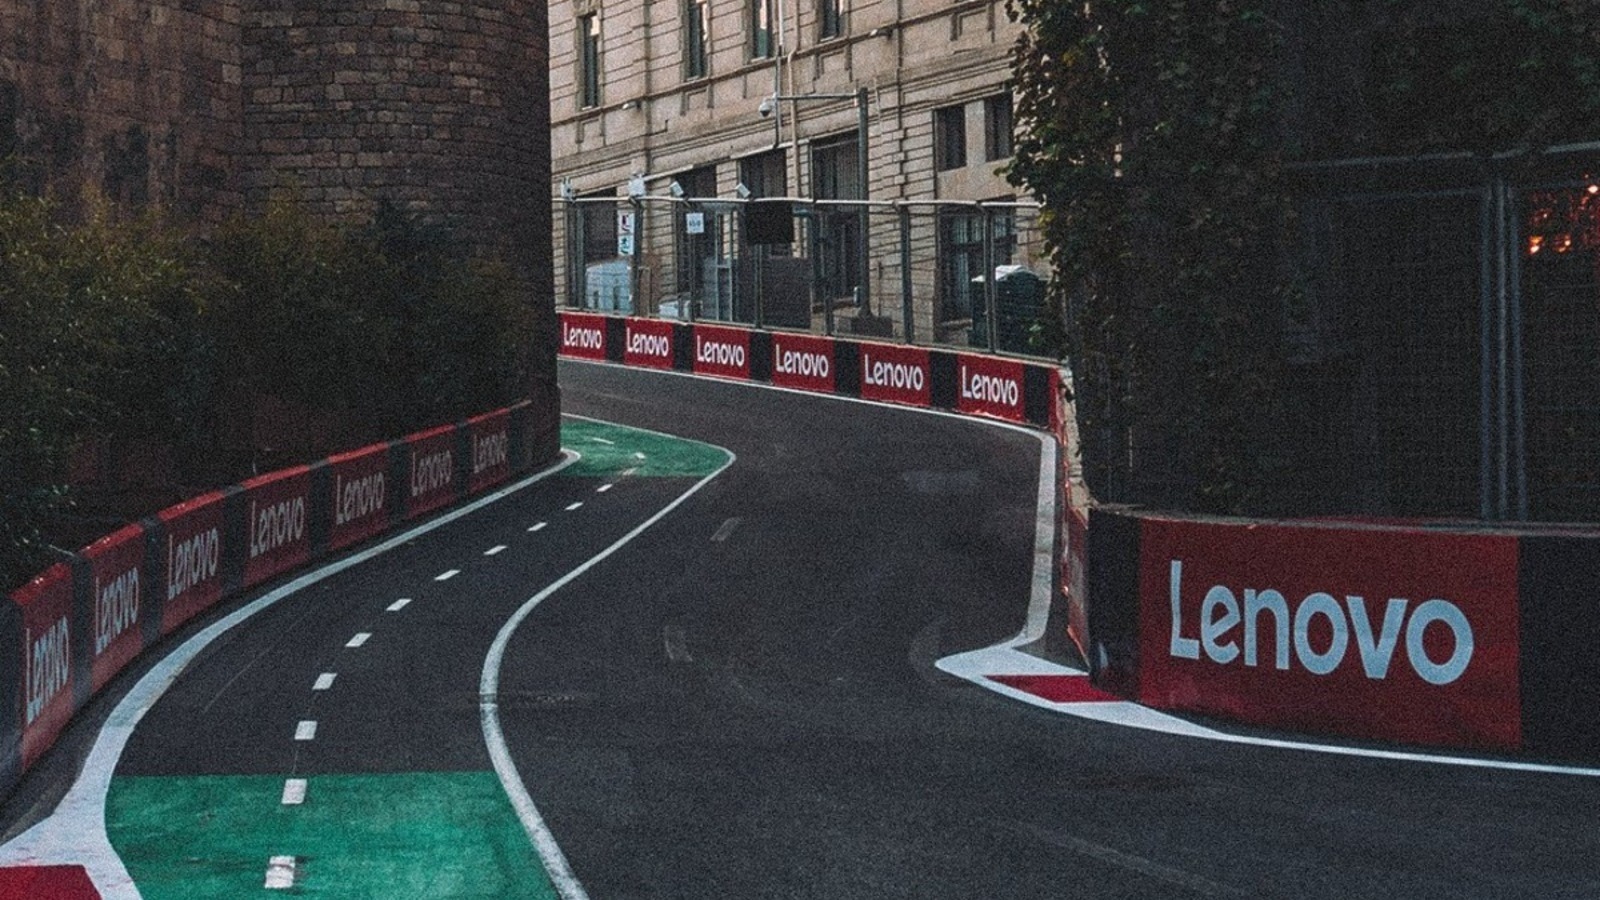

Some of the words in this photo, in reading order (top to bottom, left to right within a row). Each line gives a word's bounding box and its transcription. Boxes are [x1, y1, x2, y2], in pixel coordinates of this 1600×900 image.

[564, 323, 602, 349] Lenovo
[625, 328, 669, 357] Lenovo
[697, 335, 745, 367] Lenovo
[775, 344, 829, 377] Lenovo
[864, 355, 923, 391] Lenovo
[961, 365, 1018, 406] Lenovo
[335, 472, 385, 525] Lenovo
[250, 496, 305, 558] Lenovo
[168, 528, 219, 600] Lenovo
[1170, 560, 1475, 685] Lenovo
